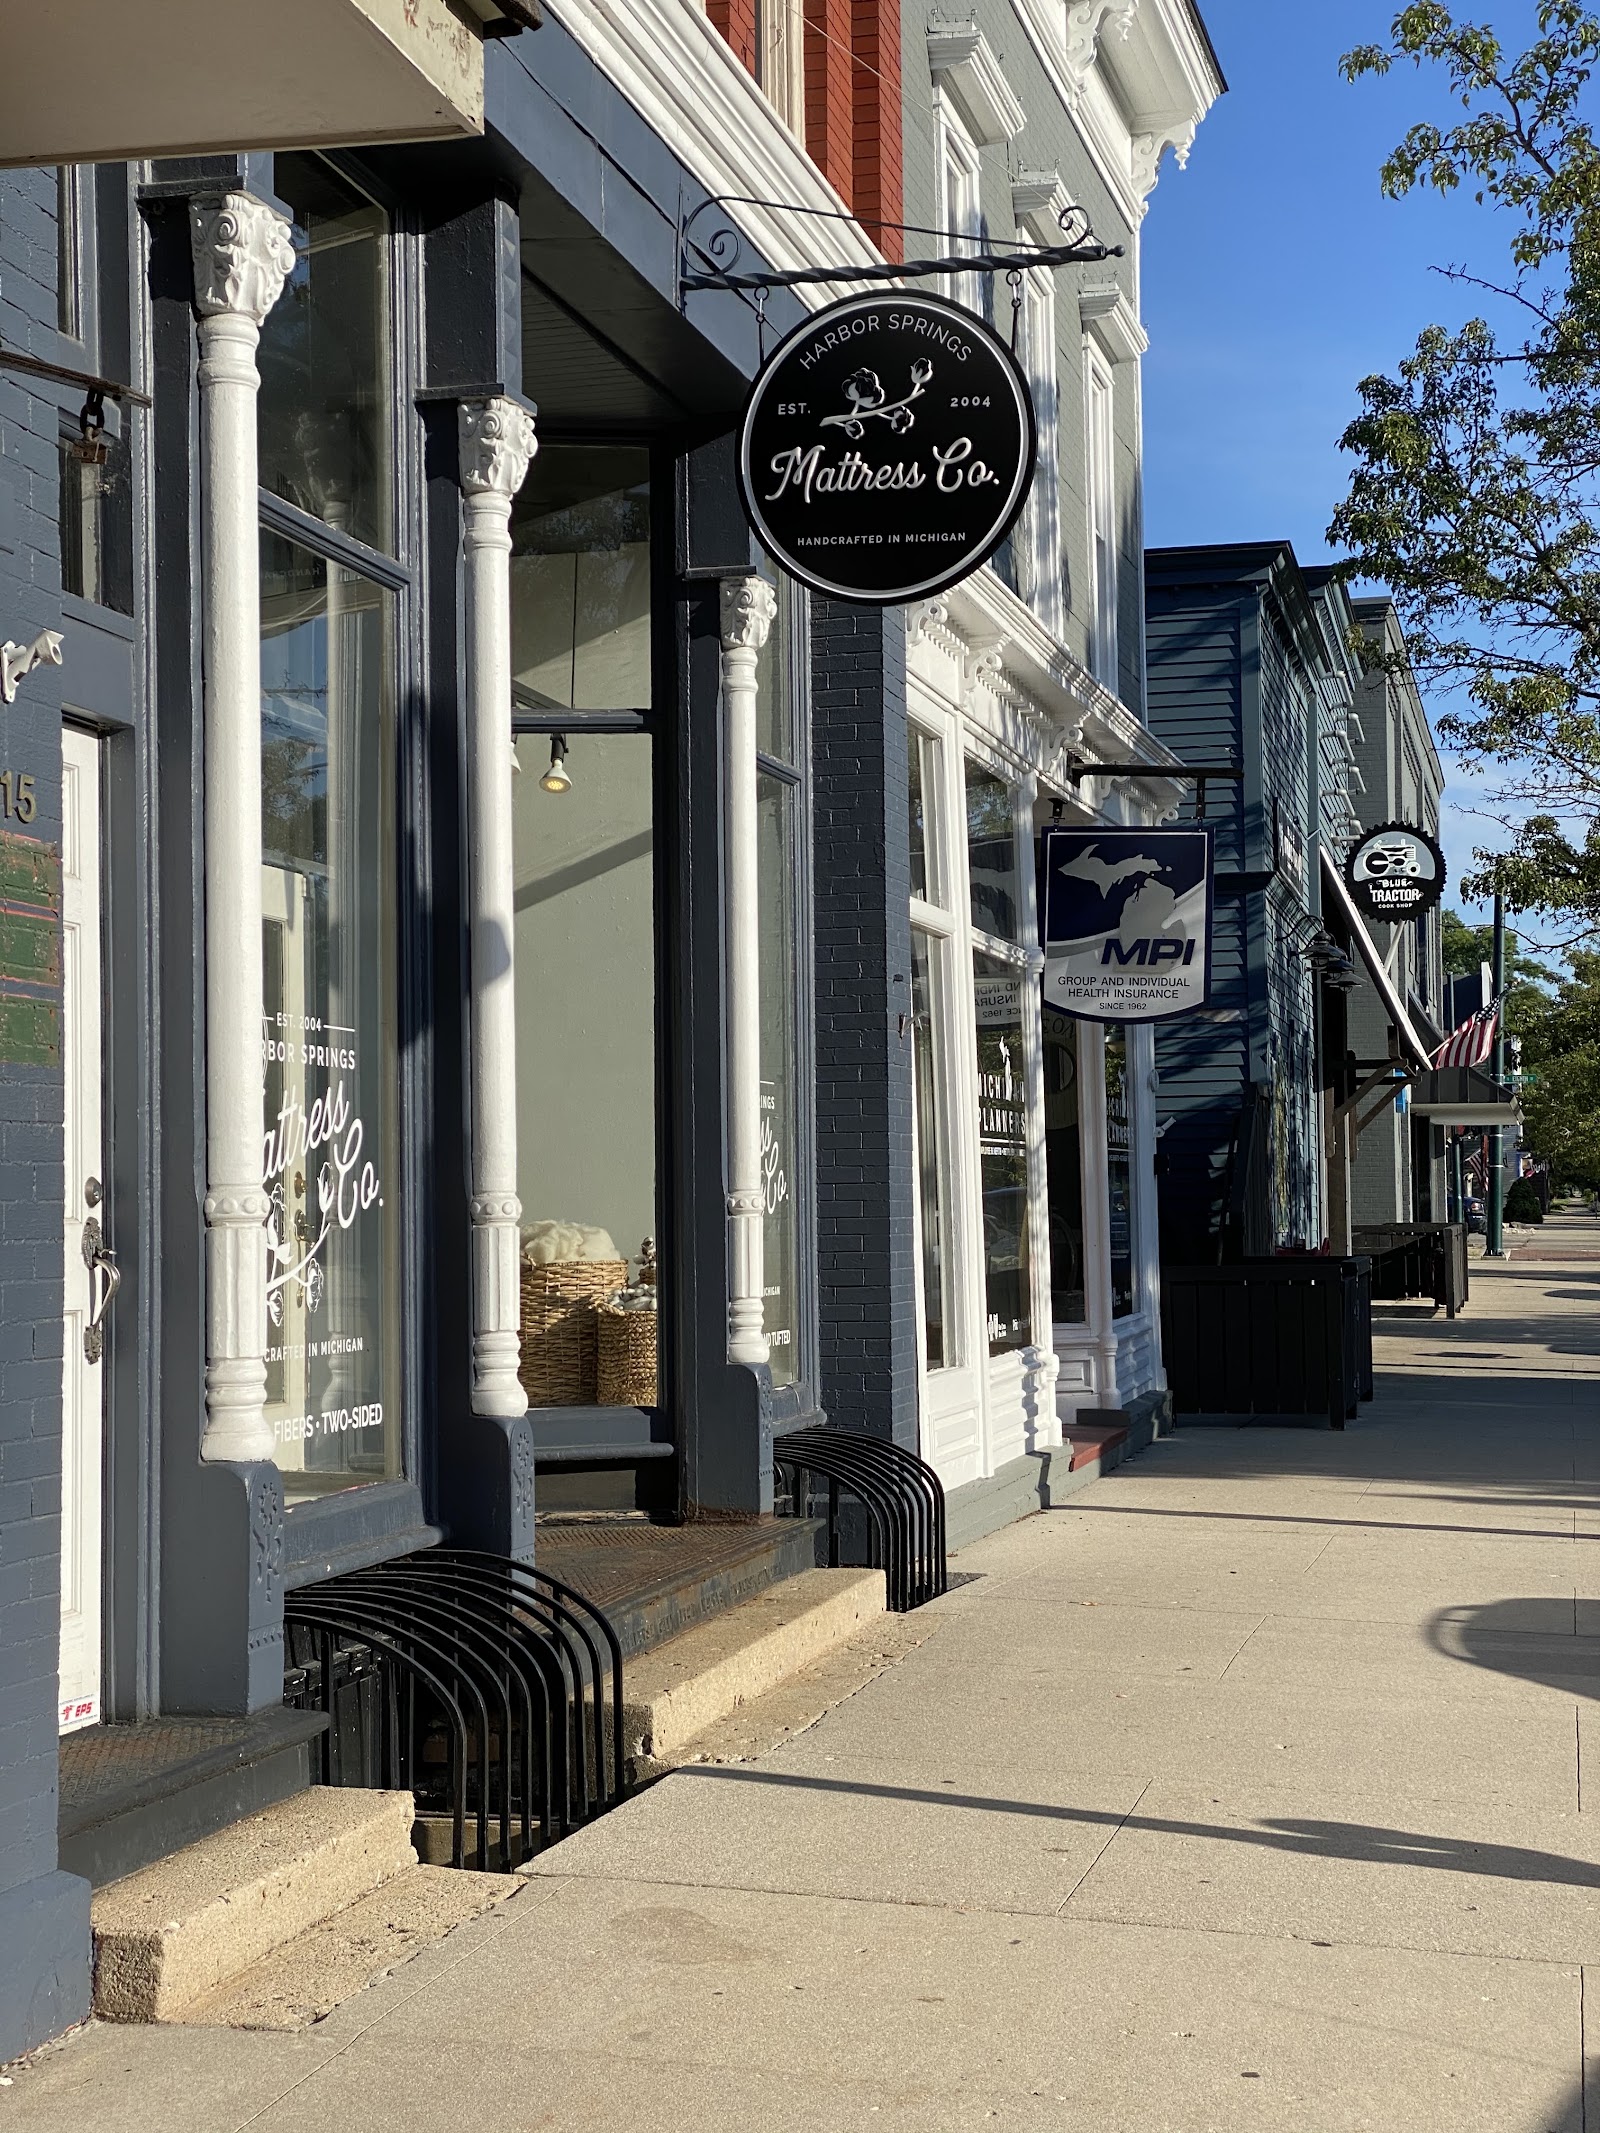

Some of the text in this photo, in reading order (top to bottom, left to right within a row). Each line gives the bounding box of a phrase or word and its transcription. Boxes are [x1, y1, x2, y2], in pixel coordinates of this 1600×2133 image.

[799, 314, 972, 370] HARBOR SPRINGS
[778, 396, 991, 415] EST. 2004
[764, 437, 1000, 503] Mattress Co.
[797, 532, 966, 546] HANDCRAFTED IN MICHIGAN
[1380, 879, 1408, 888] BLUE
[1371, 887, 1421, 902] TRACTOR
[1100, 938, 1196, 966] MPI
[1057, 976, 1190, 987] GROUP AND INDIVIDUAL
[1068, 989, 1179, 999] HEALTH INSURANCE
[1099, 1002, 1124, 1010] SINCE
[276, 1012, 321, 1031] EST. 2004
[301, 1044, 355, 1070] SPRINGS
[333, 1118, 384, 1229] Co.
[765, 1141, 789, 1214] Co.
[308, 1342, 318, 1357] IN
[320, 1337, 363, 1355] MICHIGAN
[771, 1330, 790, 1346] TUFTED
[274, 1403, 383, 1442] FIBERS TWO-SIDED
[75, 1702, 93, 1718] EPS
